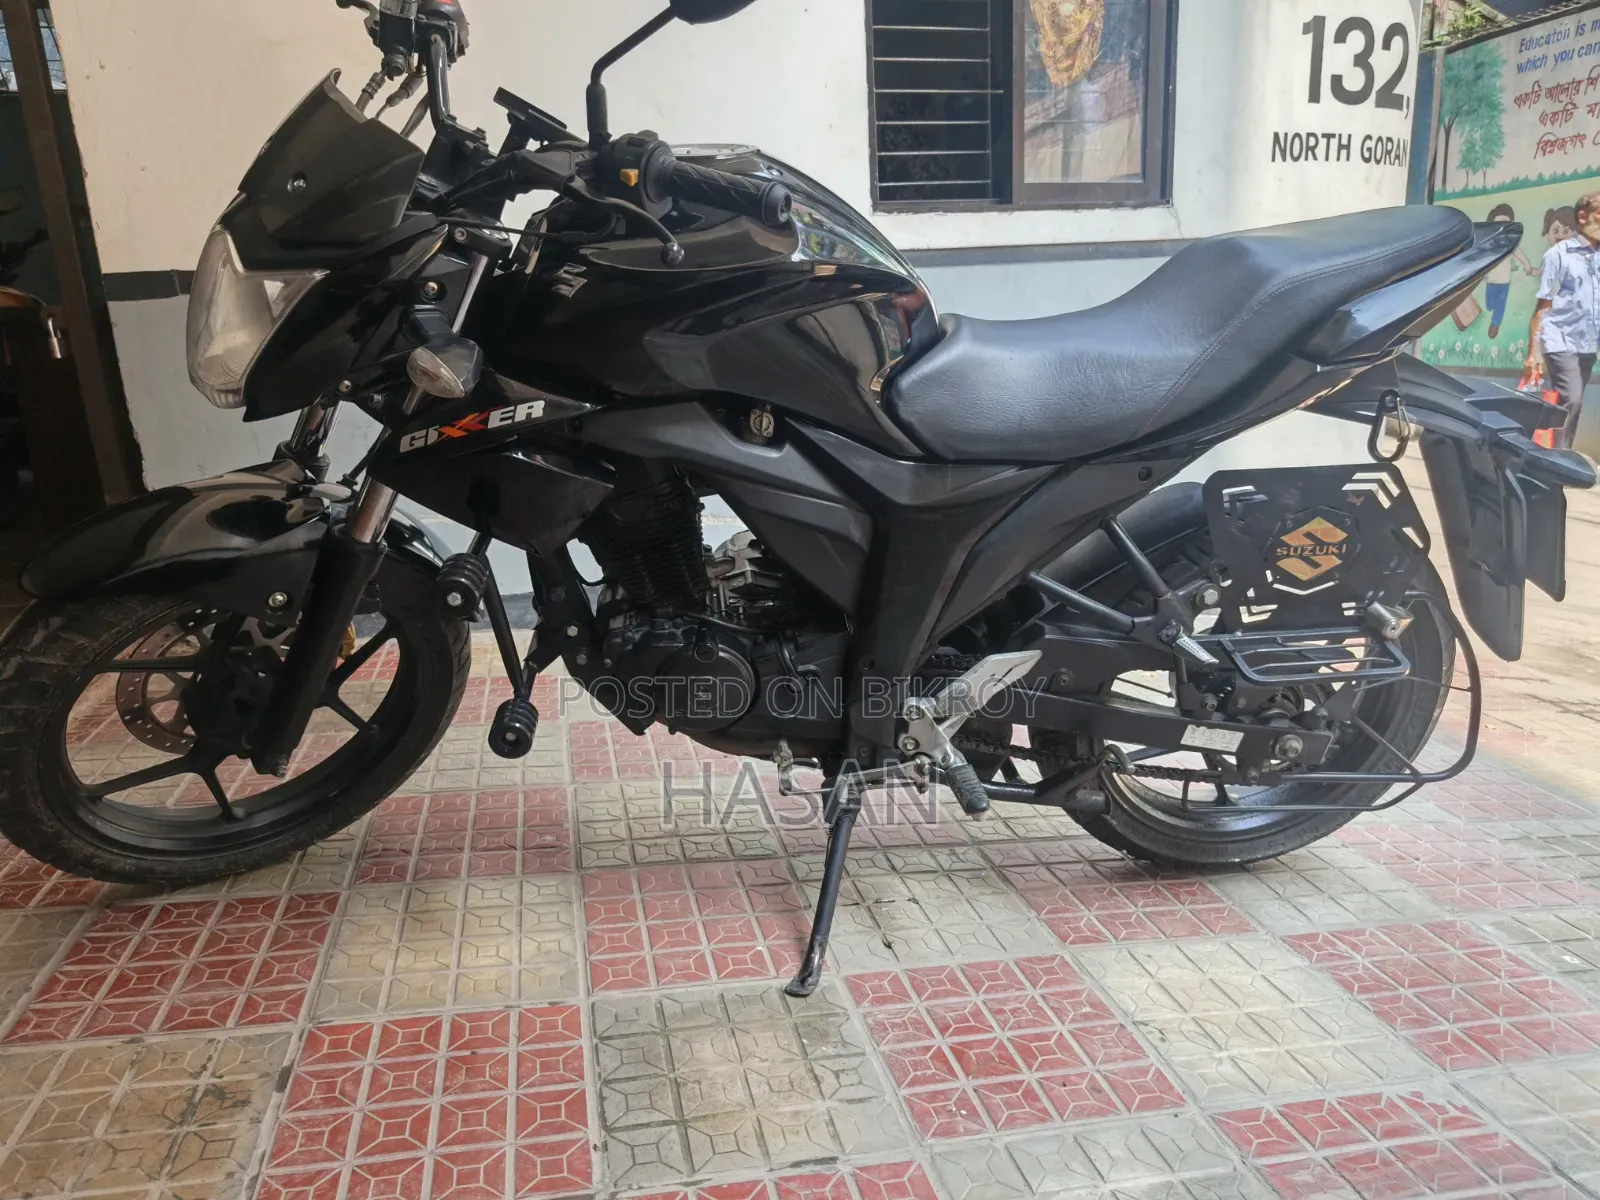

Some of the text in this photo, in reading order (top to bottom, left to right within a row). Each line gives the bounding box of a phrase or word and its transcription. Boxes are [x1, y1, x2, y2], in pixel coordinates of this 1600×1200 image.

[1574, 20, 1587, 37] is
[1302, 15, 1410, 119] 132,
[1517, 53, 1548, 75] which
[1550, 48, 1575, 72] you
[1514, 80, 1543, 110] একটি
[1539, 102, 1579, 128] একটি
[1271, 132, 1408, 168] NORTH GORAN
[1276, 543, 1347, 556] SUZUKI
